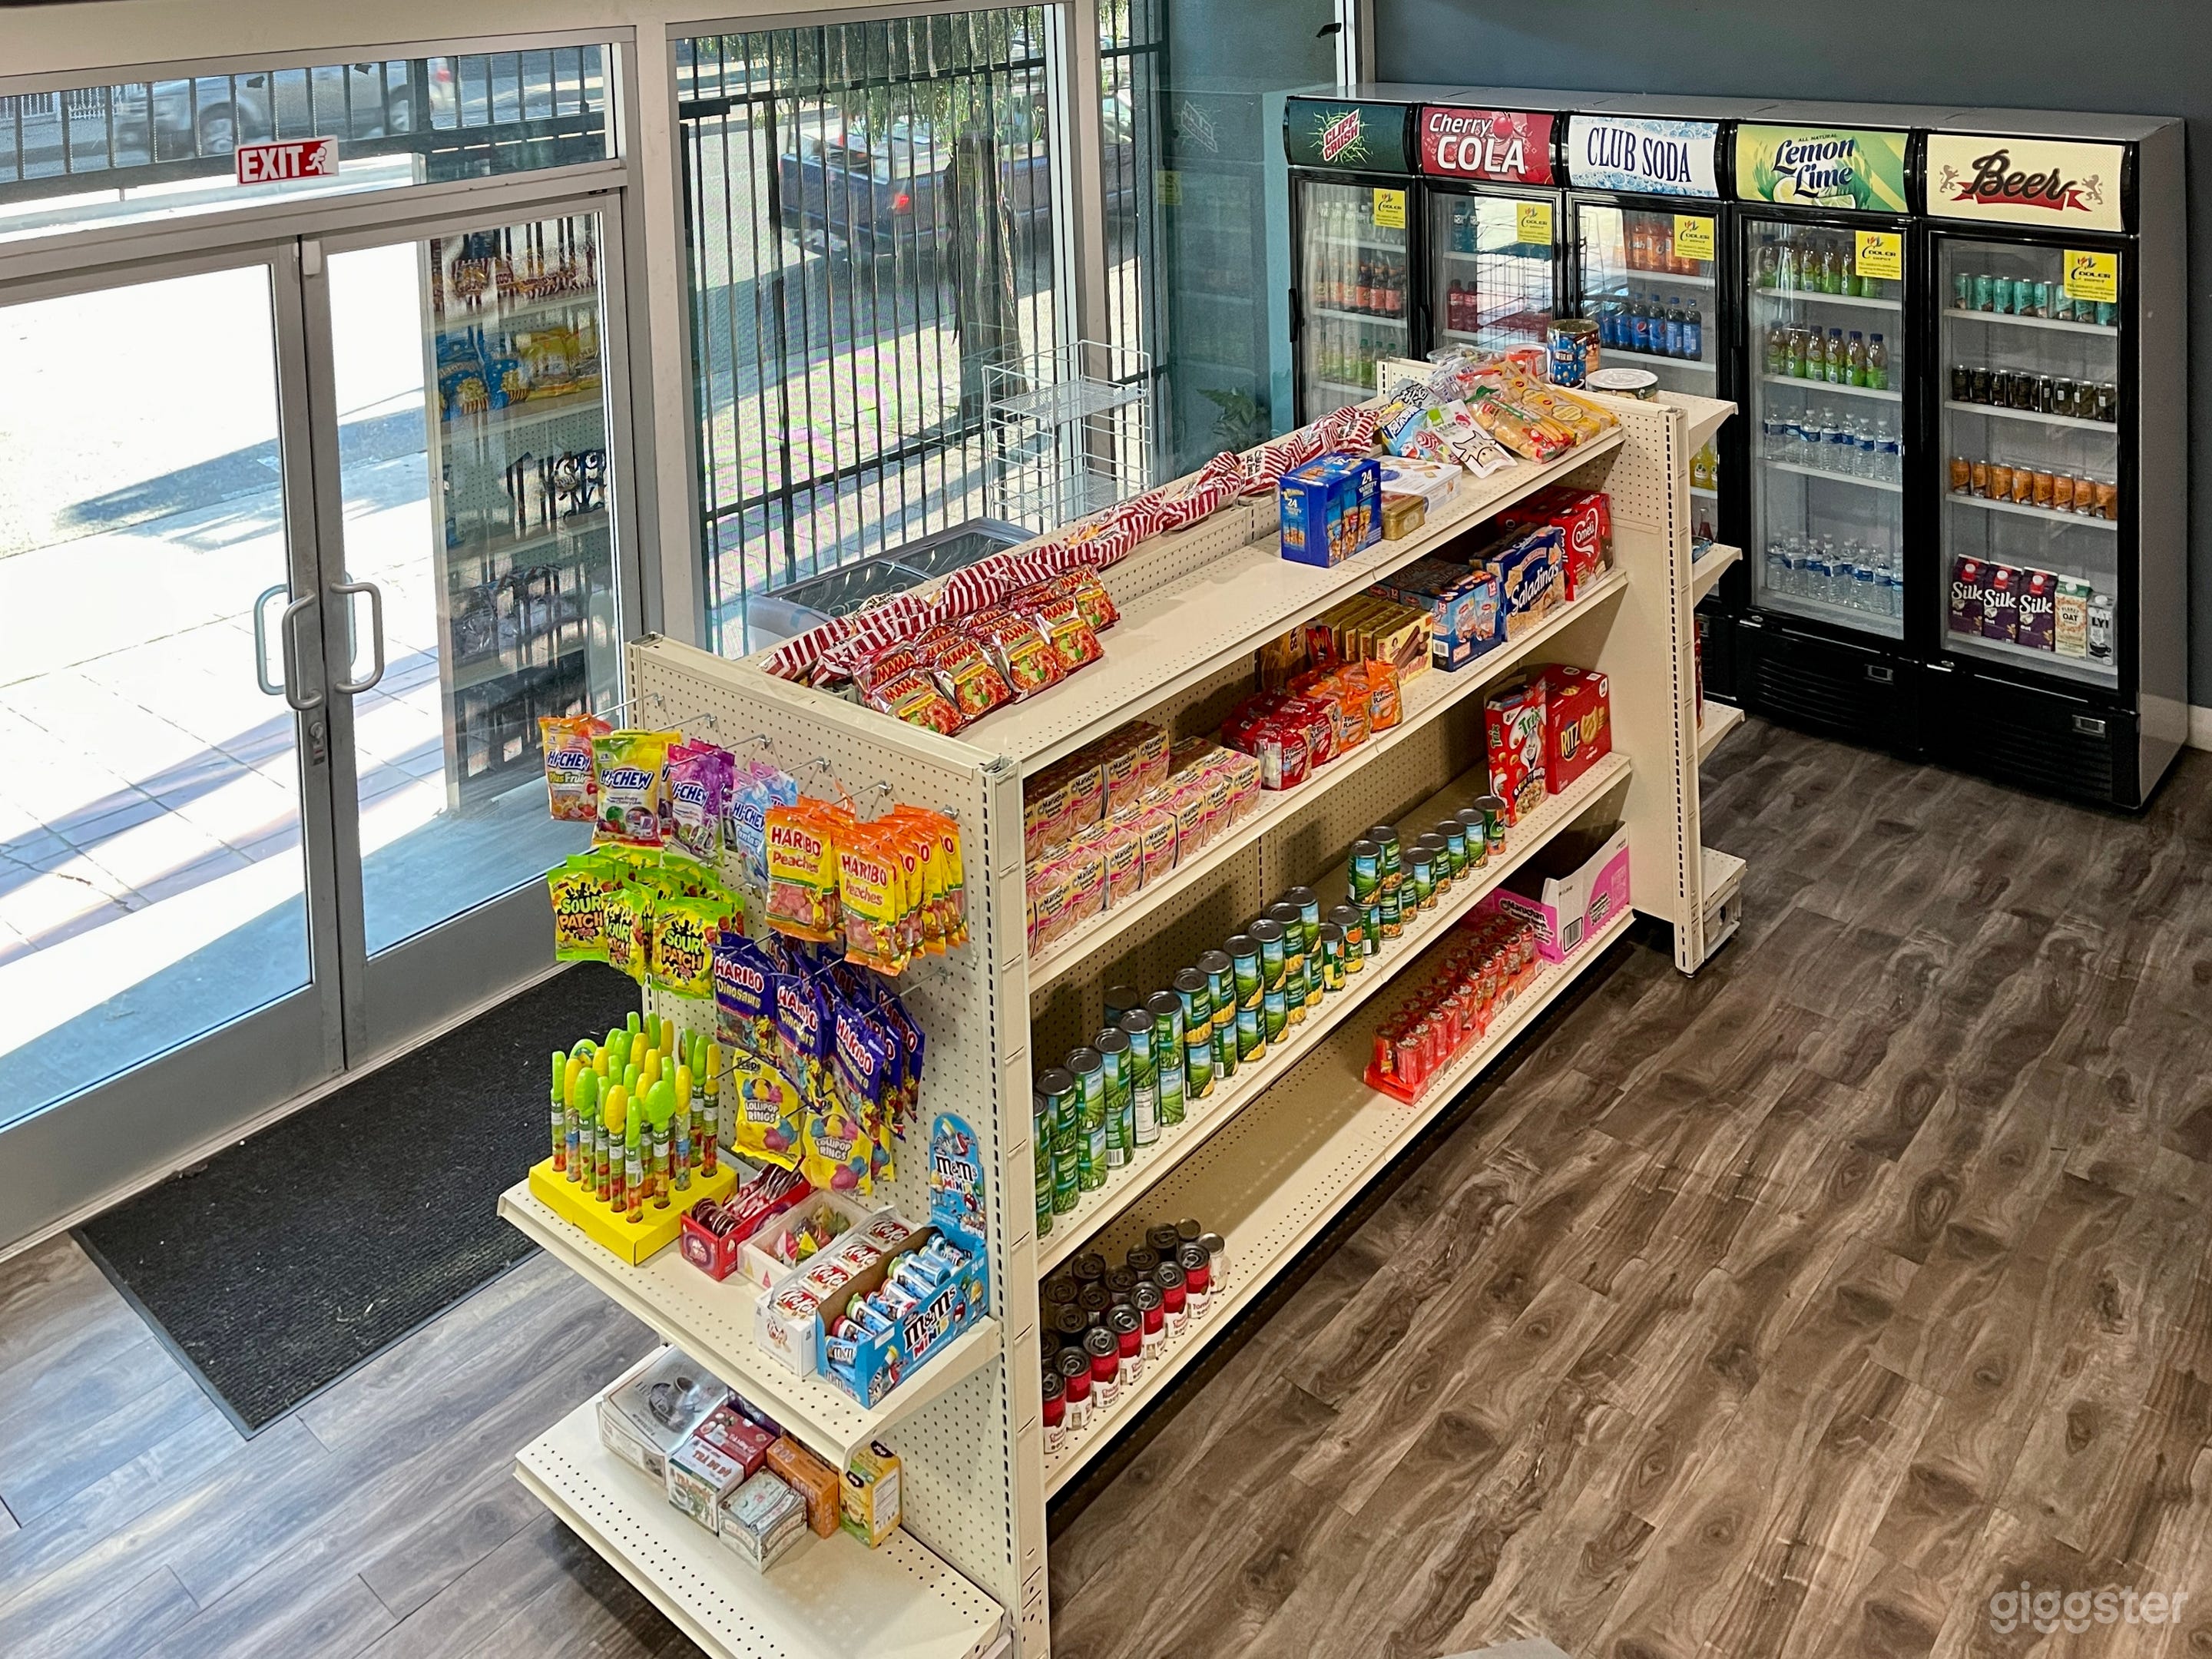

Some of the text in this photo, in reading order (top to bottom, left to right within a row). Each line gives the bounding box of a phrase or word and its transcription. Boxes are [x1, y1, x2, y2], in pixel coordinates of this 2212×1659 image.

[1324, 112, 1359, 144] CLIFF
[1429, 113, 1493, 138] Cherry
[1323, 124, 1359, 161] CRUSH
[1437, 136, 1527, 174] COLA
[1588, 127, 1692, 183] CLUB SODA
[1771, 137, 1856, 175] Lemon
[241, 144, 304, 183] EXIT
[1962, 148, 2078, 200] Beer
[1793, 163, 1854, 198] Lime
[1361, 469, 1373, 485] 24
[1287, 498, 1298, 508] 24
[1510, 561, 1559, 617] Saladinas
[1951, 581, 1984, 601] Silk
[1984, 589, 2018, 609] Silk
[2019, 594, 2054, 614] Silk
[2062, 614, 2078, 622] OAT
[876, 651, 917, 684] MAMA
[942, 638, 979, 671] MAMA
[884, 677, 922, 704] MAMA
[1489, 724, 1503, 748] Trix
[1560, 721, 1581, 757] RITZ
[601, 770, 654, 790] HI-CHEW
[771, 826, 823, 858] HARIBO
[772, 850, 819, 874] Peaches
[841, 853, 888, 889] HARIBO
[561, 896, 602, 914] SOUR
[845, 879, 883, 907] Peaches
[558, 911, 604, 929] PATCH
[1508, 899, 1546, 922] Maruchan
[665, 929, 702, 954] SOUR
[661, 944, 704, 972] PATCH
[714, 955, 765, 994] HARIBO
[715, 979, 761, 1009] Dinosaurs
[745, 1101, 780, 1113] LOLLIPOP
[747, 1111, 776, 1122] RINGS
[816, 1137, 853, 1153] LOLLIPOP
[820, 1146, 848, 1161] RINGS
